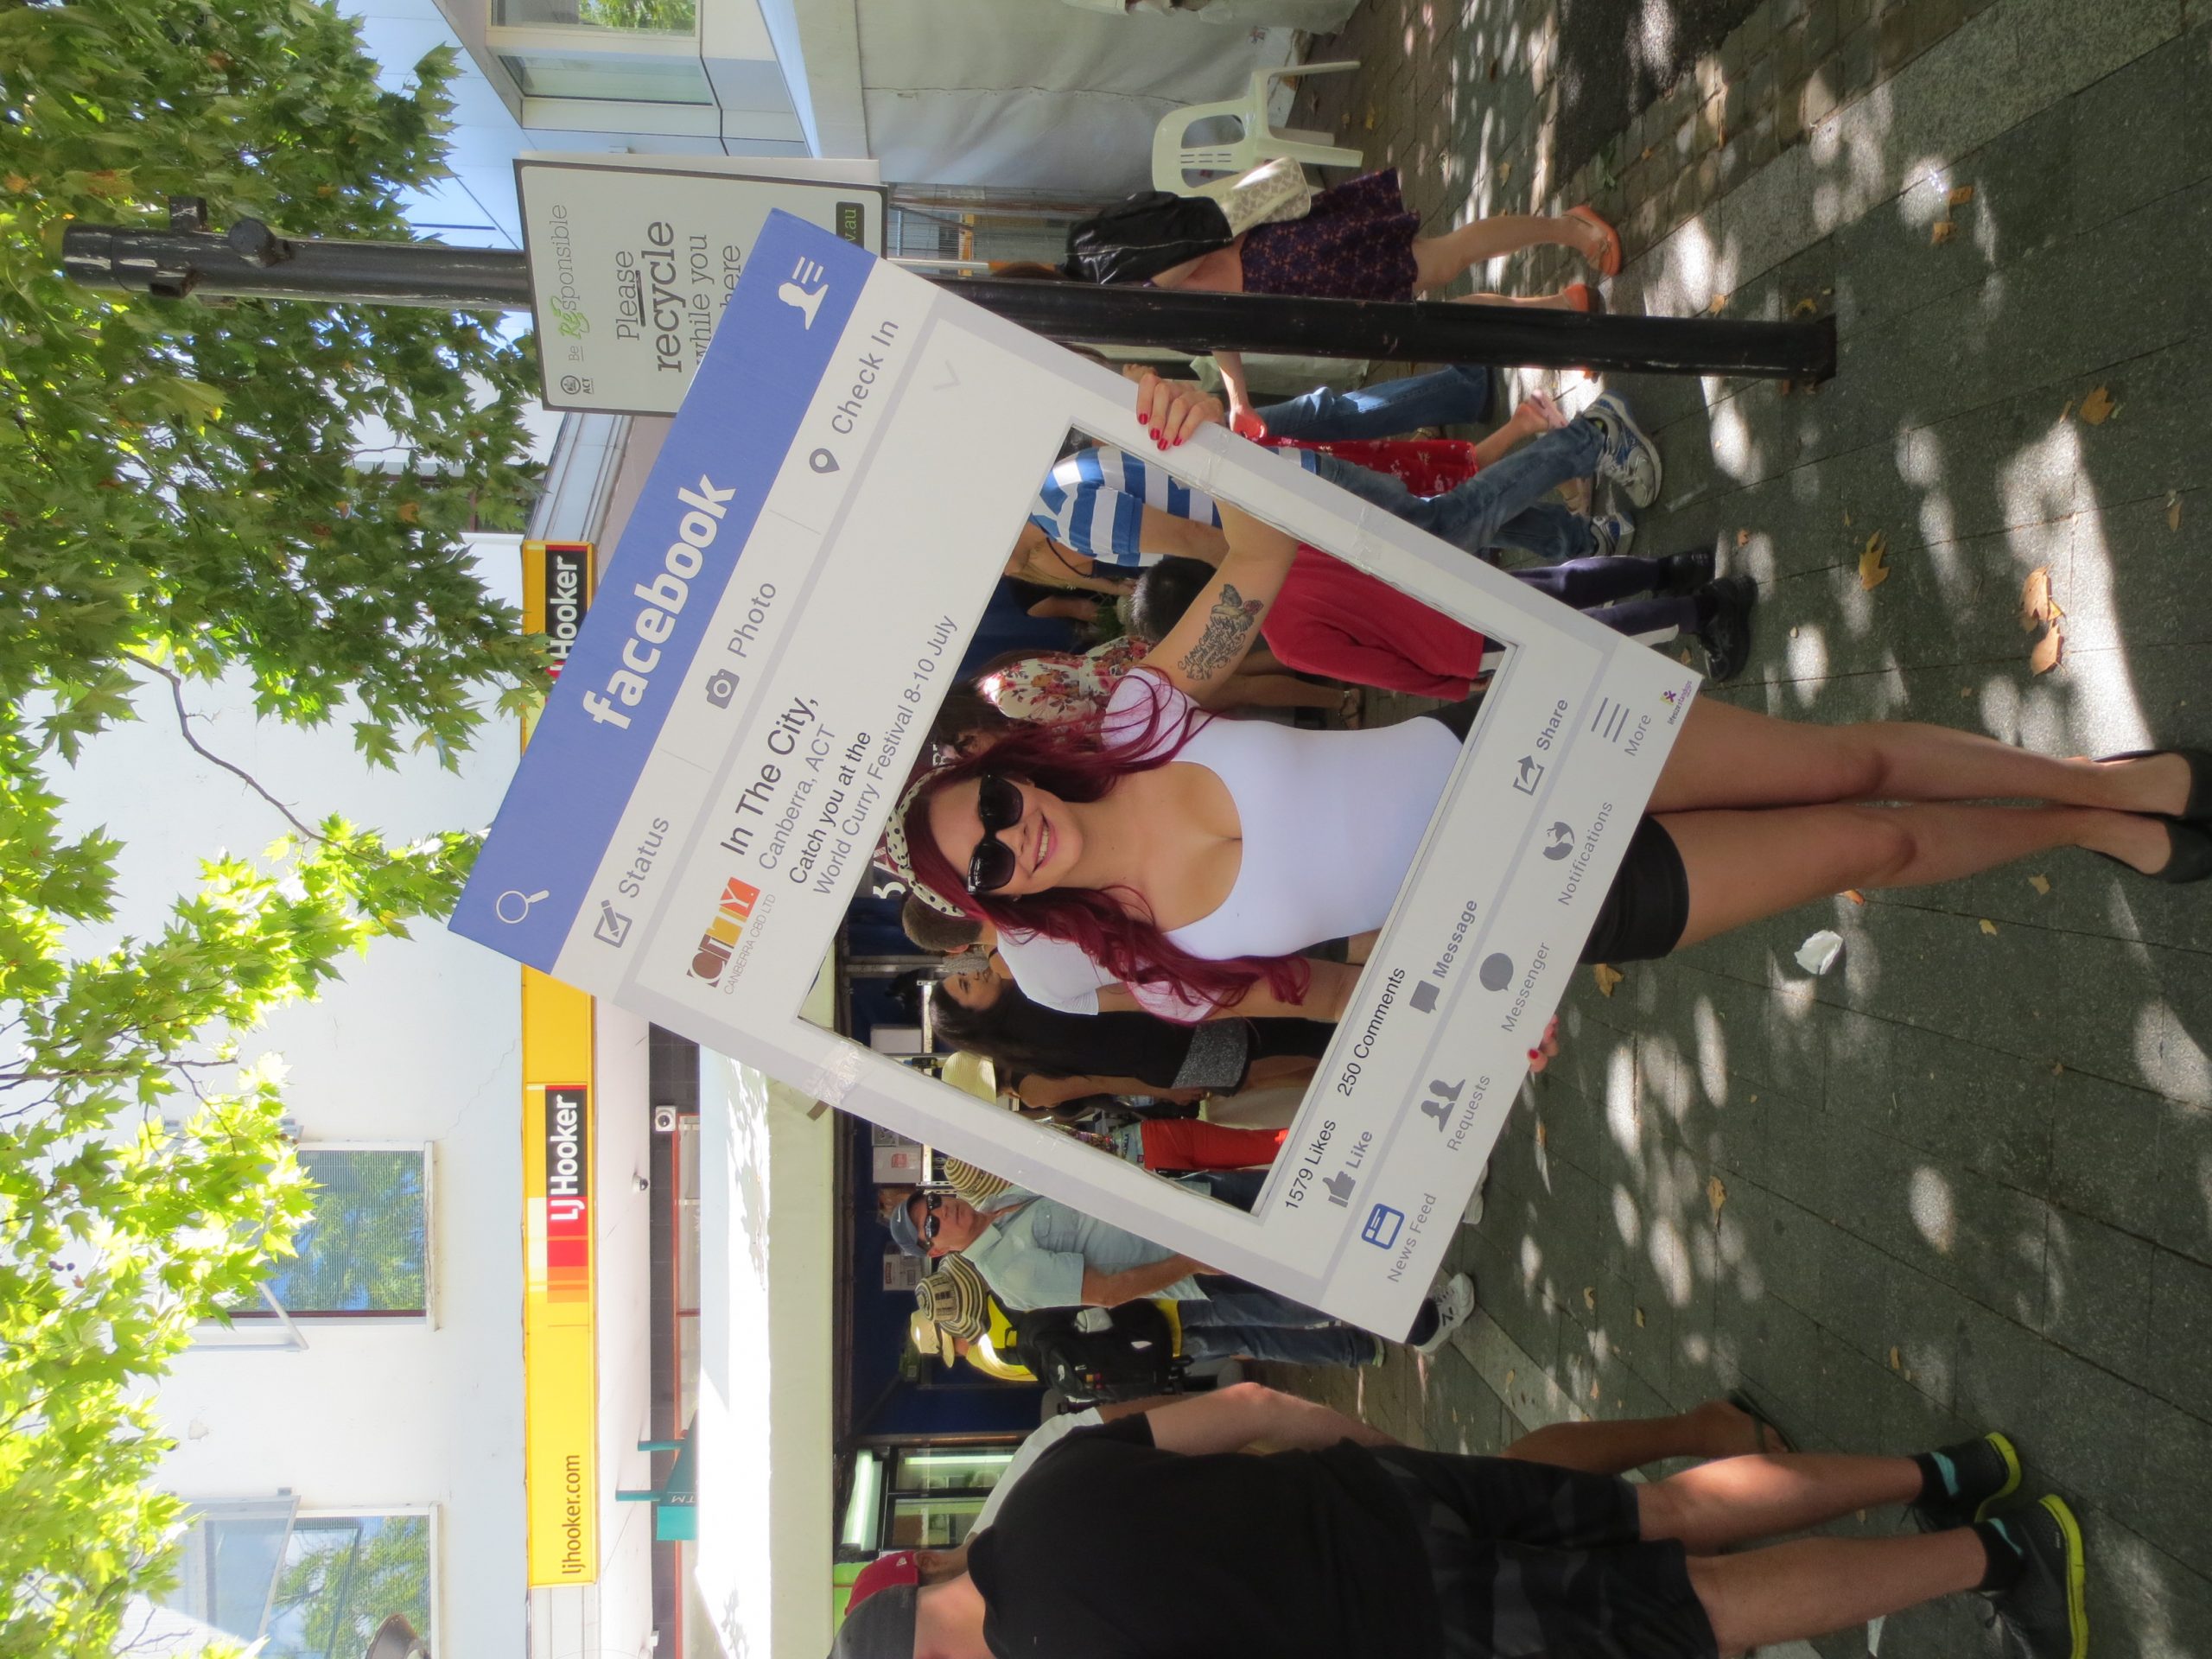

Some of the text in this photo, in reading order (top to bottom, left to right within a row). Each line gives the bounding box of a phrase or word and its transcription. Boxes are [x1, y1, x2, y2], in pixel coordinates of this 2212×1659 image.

[548, 205, 586, 361] Be Responsible
[614, 251, 640, 341] Please
[642, 221, 686, 373] recycle
[689, 234, 715, 285] you
[582, 377, 591, 394] ACT
[830, 320, 900, 435] Check In
[549, 554, 578, 659] Hooker
[582, 473, 737, 731] facebook
[726, 582, 777, 659] Photo
[719, 696, 820, 856] In The City,
[811, 614, 959, 895] World Curry Festival 8-10 July
[1535, 698, 1569, 752] Share
[1623, 714, 1652, 758] More
[758, 722, 836, 871] Canberra, ACT
[788, 731, 872, 885] Catch you at the
[617, 817, 671, 899] Status
[1556, 801, 1613, 906] Notifications
[722, 893, 777, 996] CANBERRA CBD LTD
[1431, 899, 1478, 980] Message
[1500, 941, 1551, 1033] Messenger
[1284, 967, 1406, 1210] 1579 Likes 250 Comments
[1446, 1074, 1491, 1153] Requests
[550, 1094, 586, 1221] LJ Hooker
[1344, 1130, 1374, 1170] Like
[1386, 1192, 1438, 1284] News Feed
[561, 1454, 587, 1575] ljhooker.com
